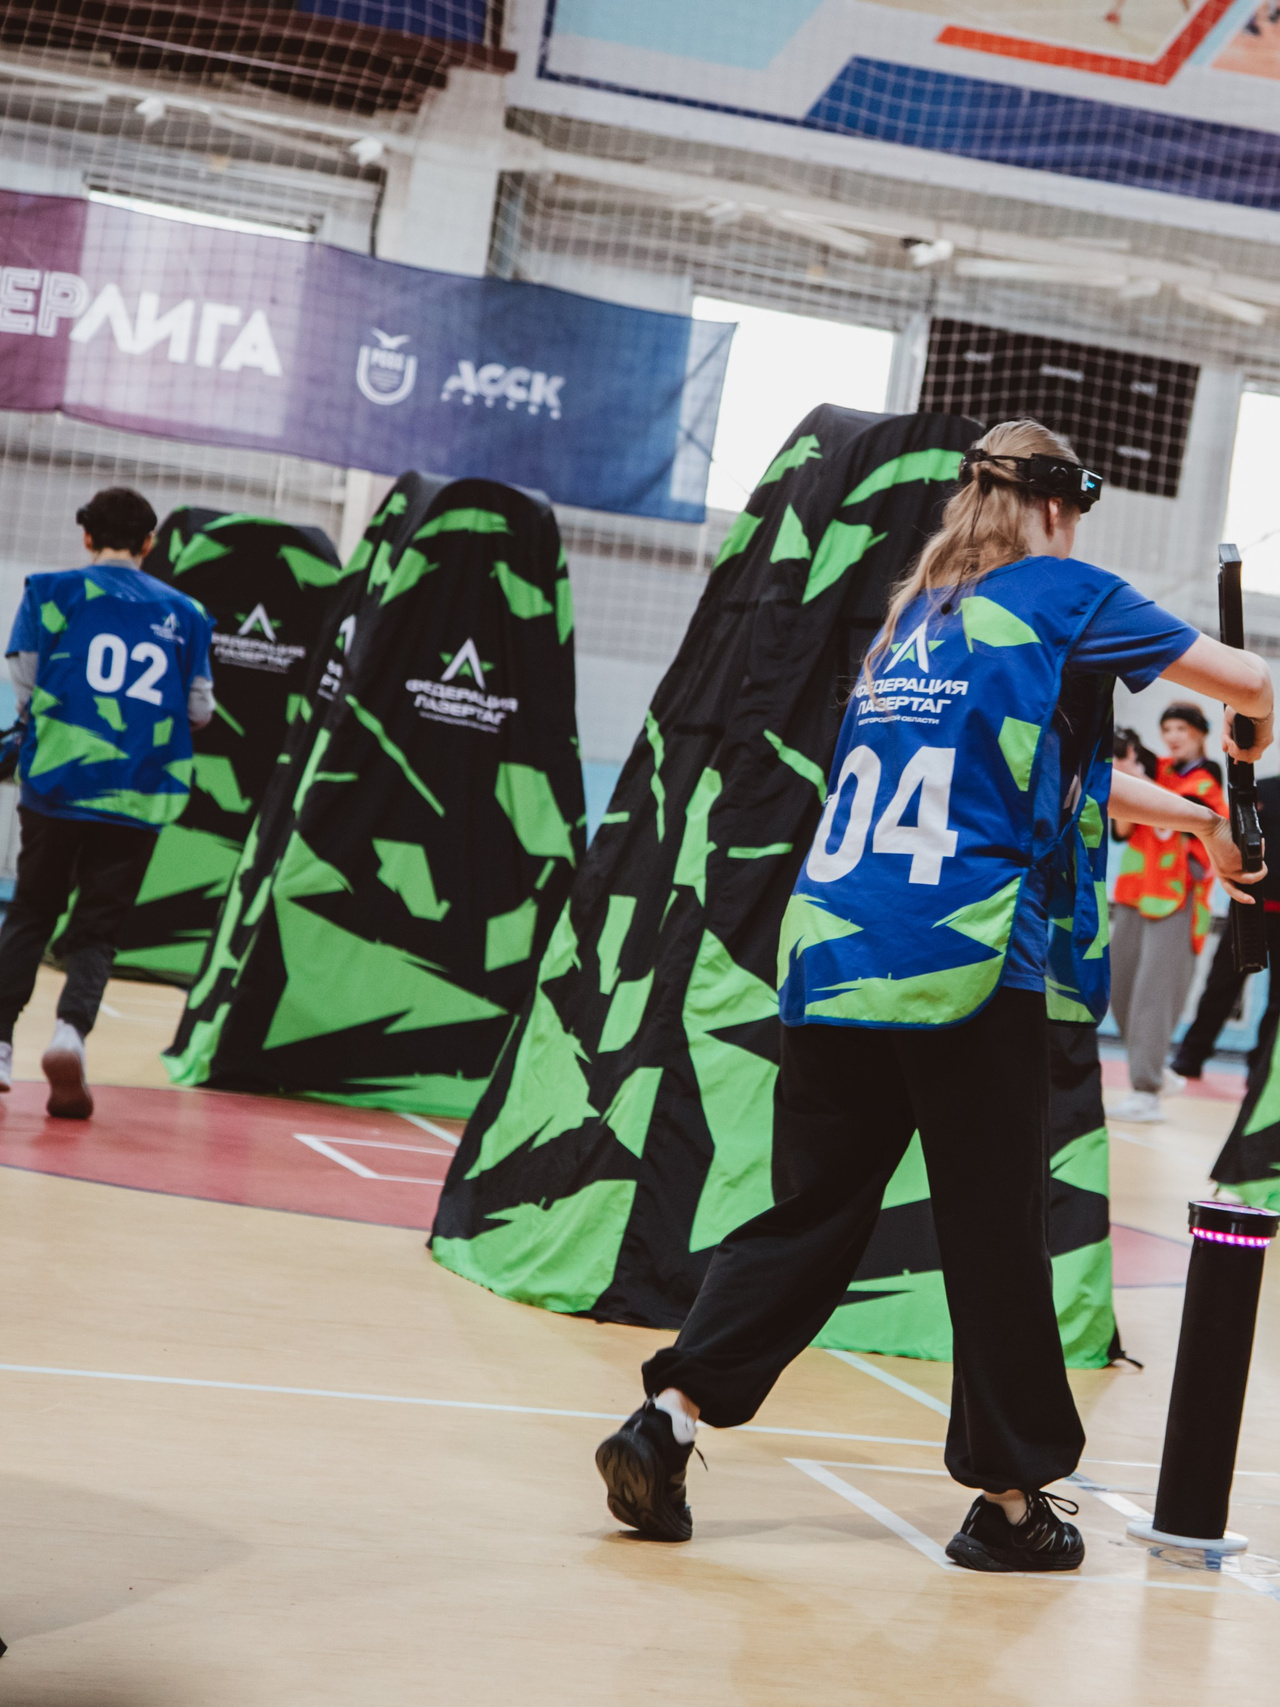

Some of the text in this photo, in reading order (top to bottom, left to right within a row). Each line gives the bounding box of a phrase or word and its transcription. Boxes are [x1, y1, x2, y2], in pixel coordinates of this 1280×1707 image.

[86, 633, 168, 706] 02
[405, 679, 518, 713] ФЕДЕРАЦИЯ
[414, 694, 506, 725] ЛАЗЕРТАГ
[857, 696, 952, 716] ЛАЗЕРТАГ
[806, 745, 958, 885] 04
